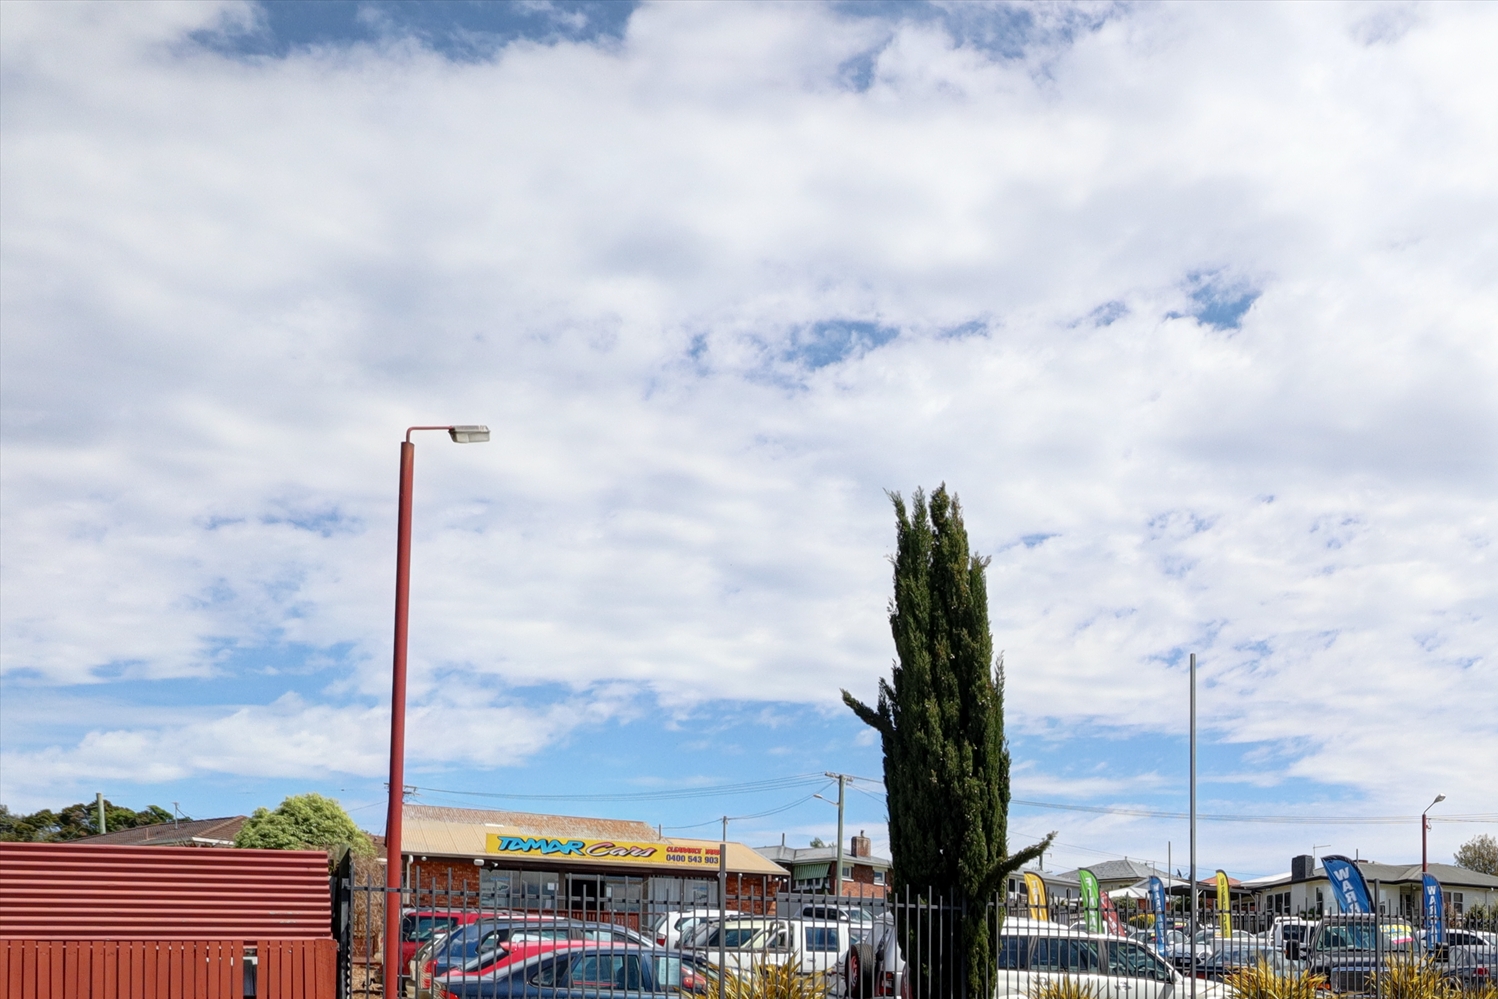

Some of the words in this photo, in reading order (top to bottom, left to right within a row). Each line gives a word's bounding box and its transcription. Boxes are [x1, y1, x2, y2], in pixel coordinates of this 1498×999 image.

[497, 836, 585, 856] TAMAR
[586, 842, 658, 858] Cars
[666, 854, 685, 862] 0400
[688, 855, 702, 864] 543
[705, 856, 719, 864] 903
